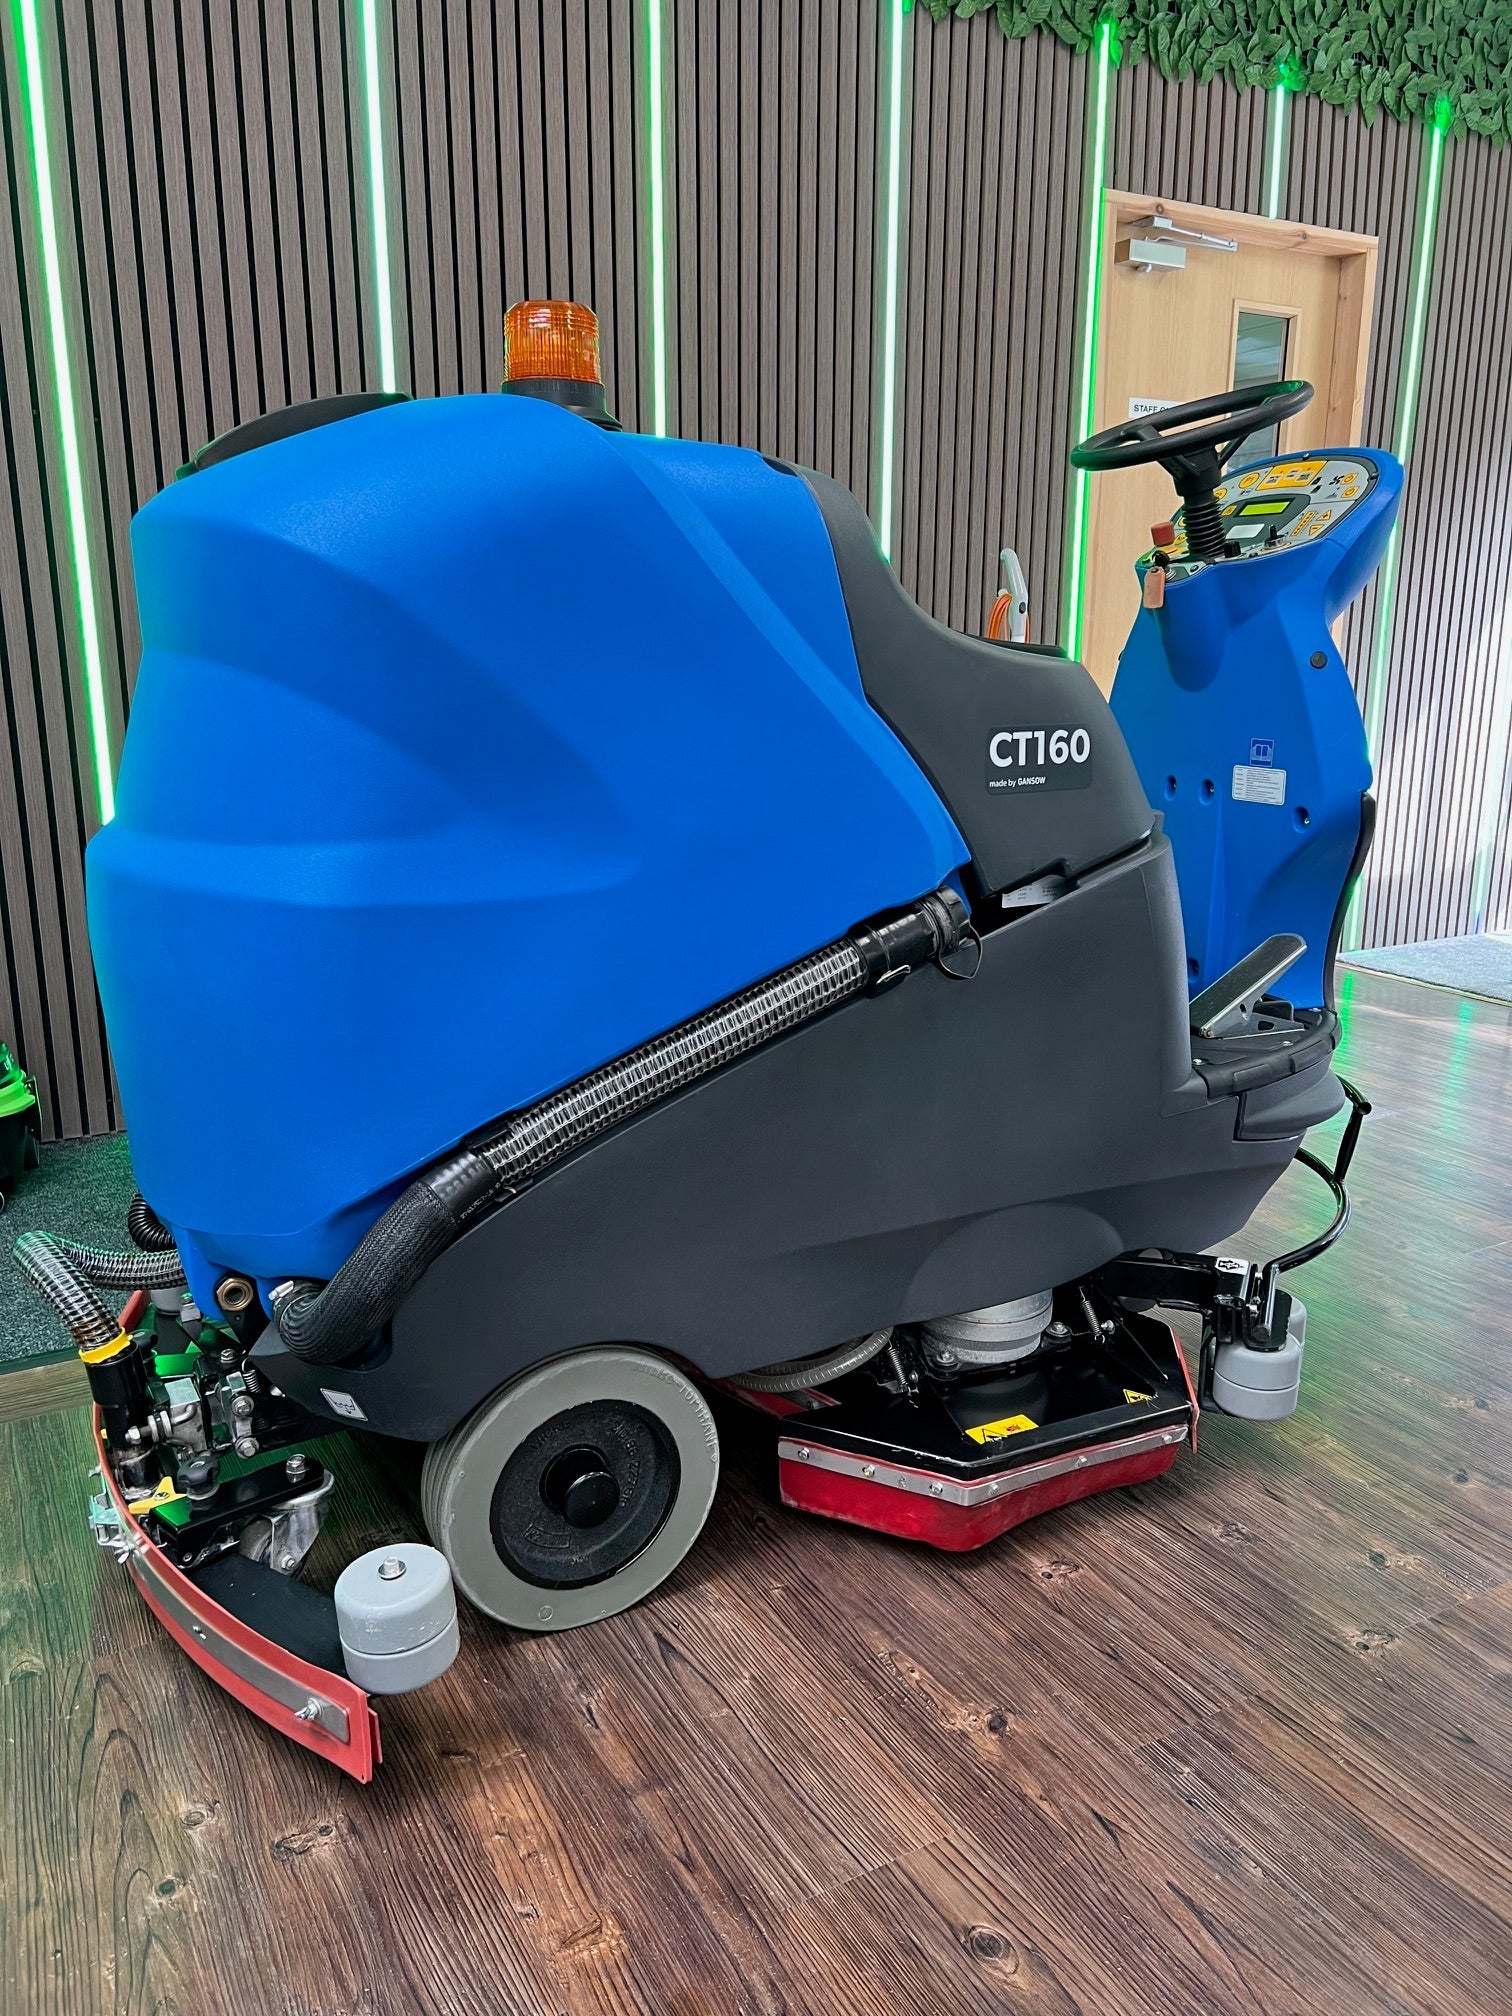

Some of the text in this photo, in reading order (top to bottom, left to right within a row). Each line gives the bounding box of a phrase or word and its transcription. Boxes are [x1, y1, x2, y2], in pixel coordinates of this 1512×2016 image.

[1133, 404, 1158, 413] STAFF
[989, 728, 1091, 768] CT160
[989, 776, 1046, 788] made by GANSOW
